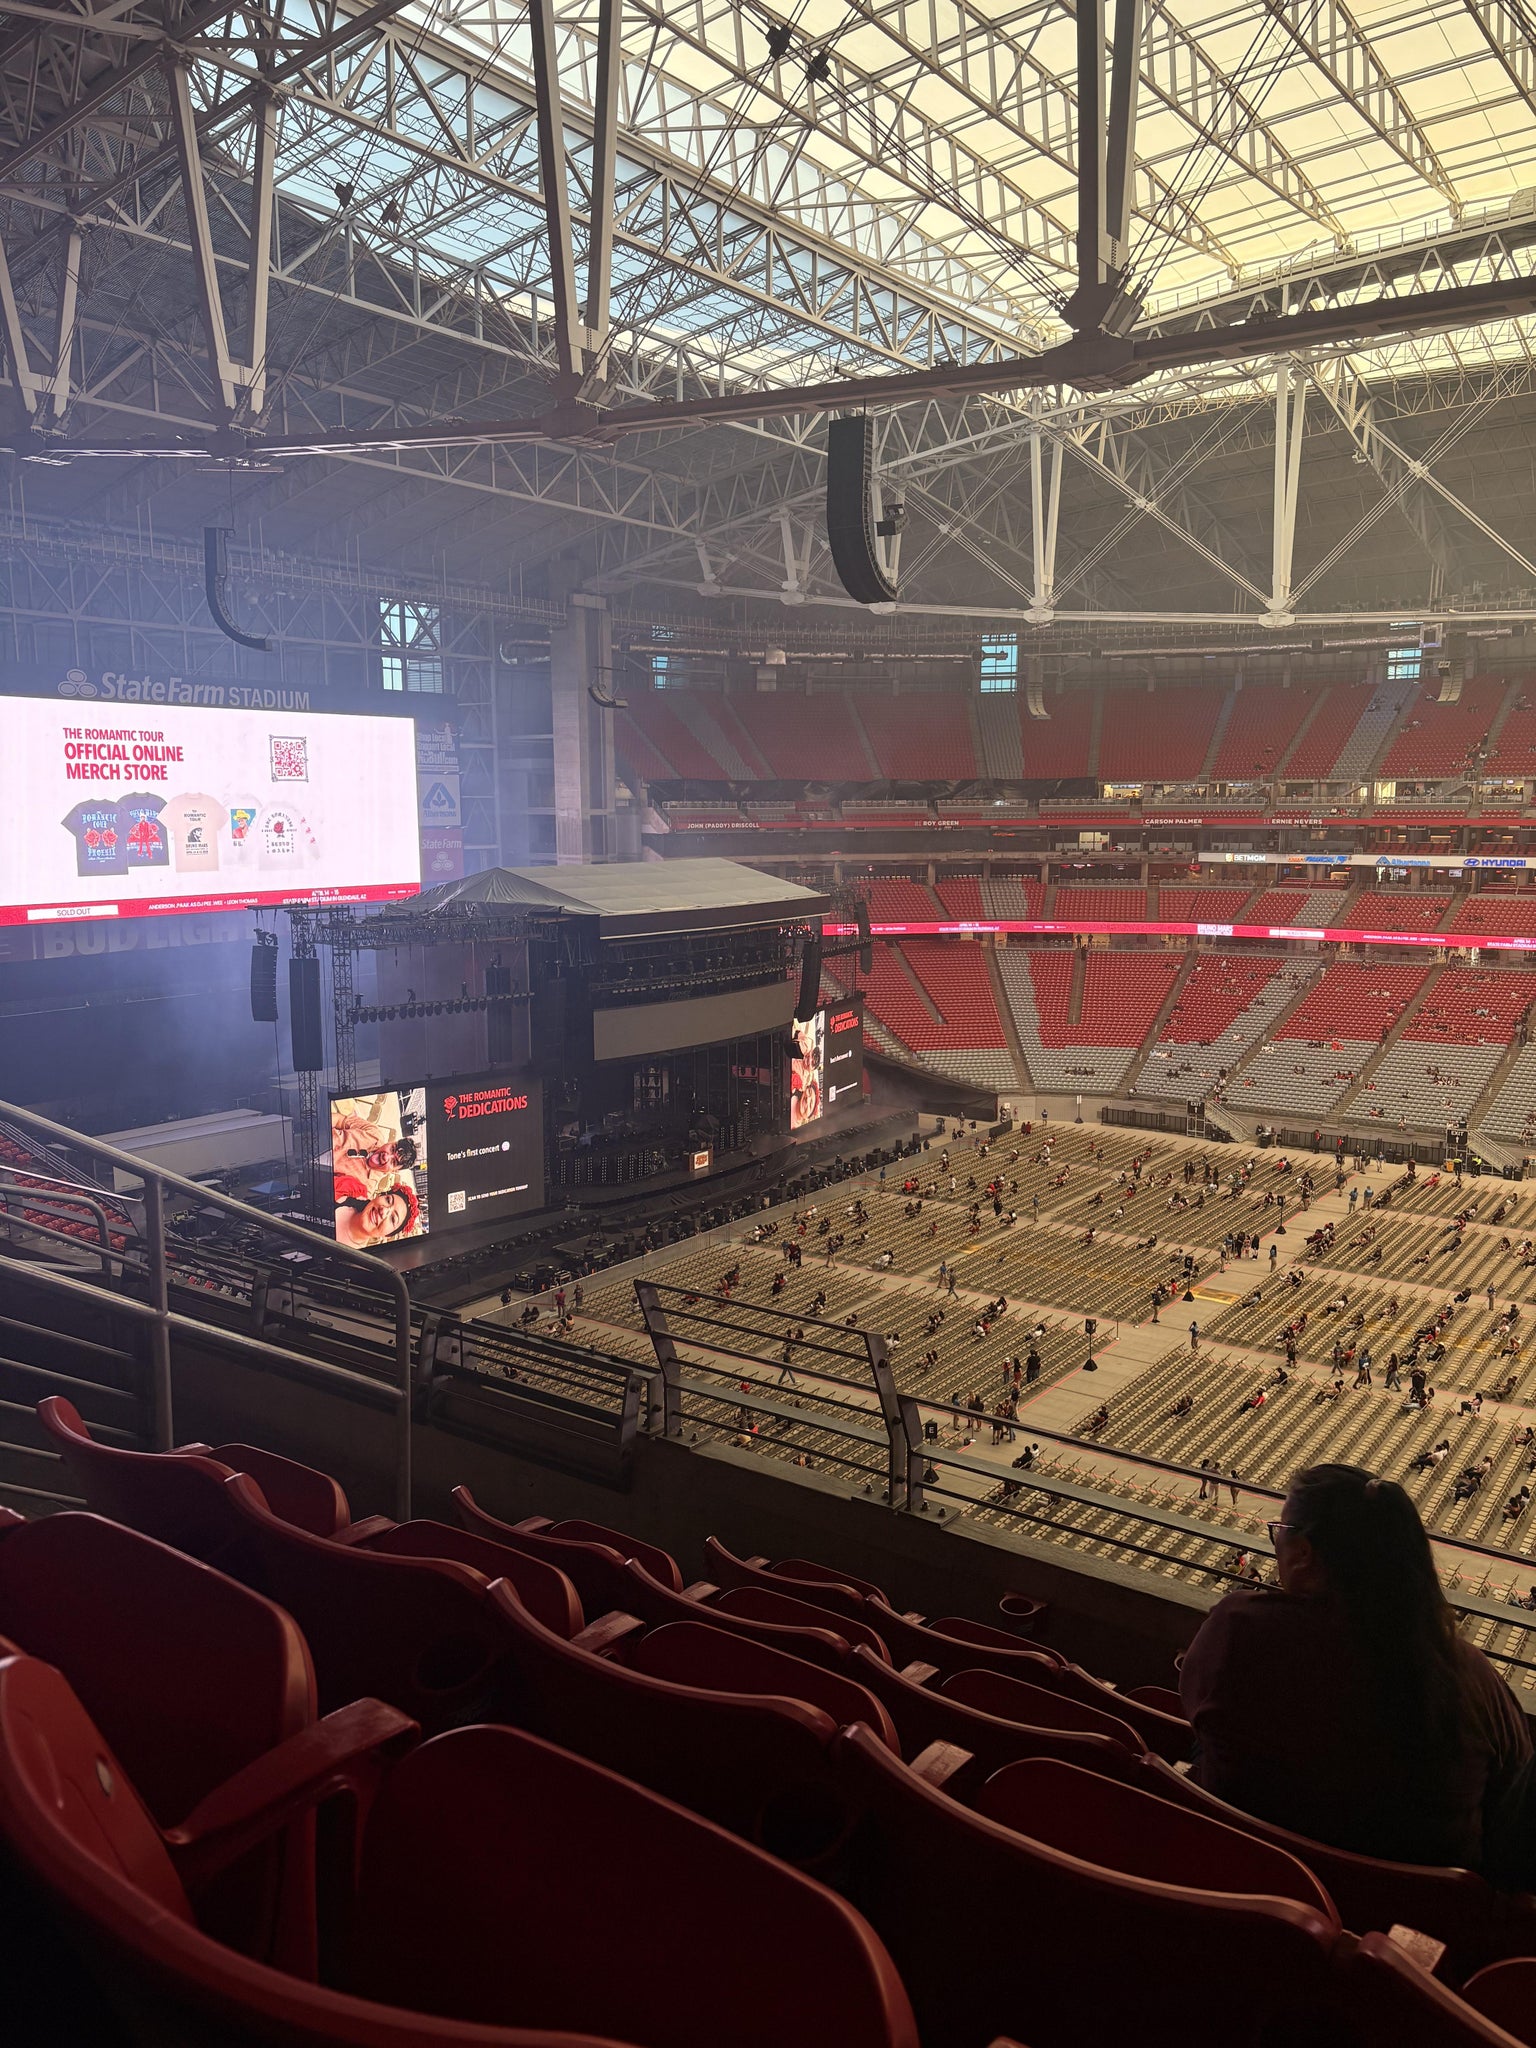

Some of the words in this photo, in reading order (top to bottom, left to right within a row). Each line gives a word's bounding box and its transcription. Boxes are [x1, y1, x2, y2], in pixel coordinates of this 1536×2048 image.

[229, 686, 310, 711] STADIUM
[63, 727, 82, 740] THE
[85, 728, 137, 741] ROMANTIC
[138, 730, 164, 743] TOUR
[64, 742, 130, 761] OFFICIAL
[133, 744, 184, 763] ONLINE
[66, 763, 120, 780] MERCH
[124, 763, 168, 781] STORE
[1234, 854, 1266, 862] BETMGM
[1481, 858, 1527, 868] HYUNDAI
[56, 908, 75, 917] SOLD
[76, 907, 91, 915] OUT
[44, 916, 138, 960] BUD
[458, 1093, 473, 1104] THE
[473, 1087, 511, 1102] ROMANTIC
[458, 1095, 528, 1119] DEDICATIONS
[447, 1150, 466, 1161] Tone's
[466, 1148, 478, 1159] first
[478, 1144, 500, 1156] concert
[929, 1426, 934, 1434] E
